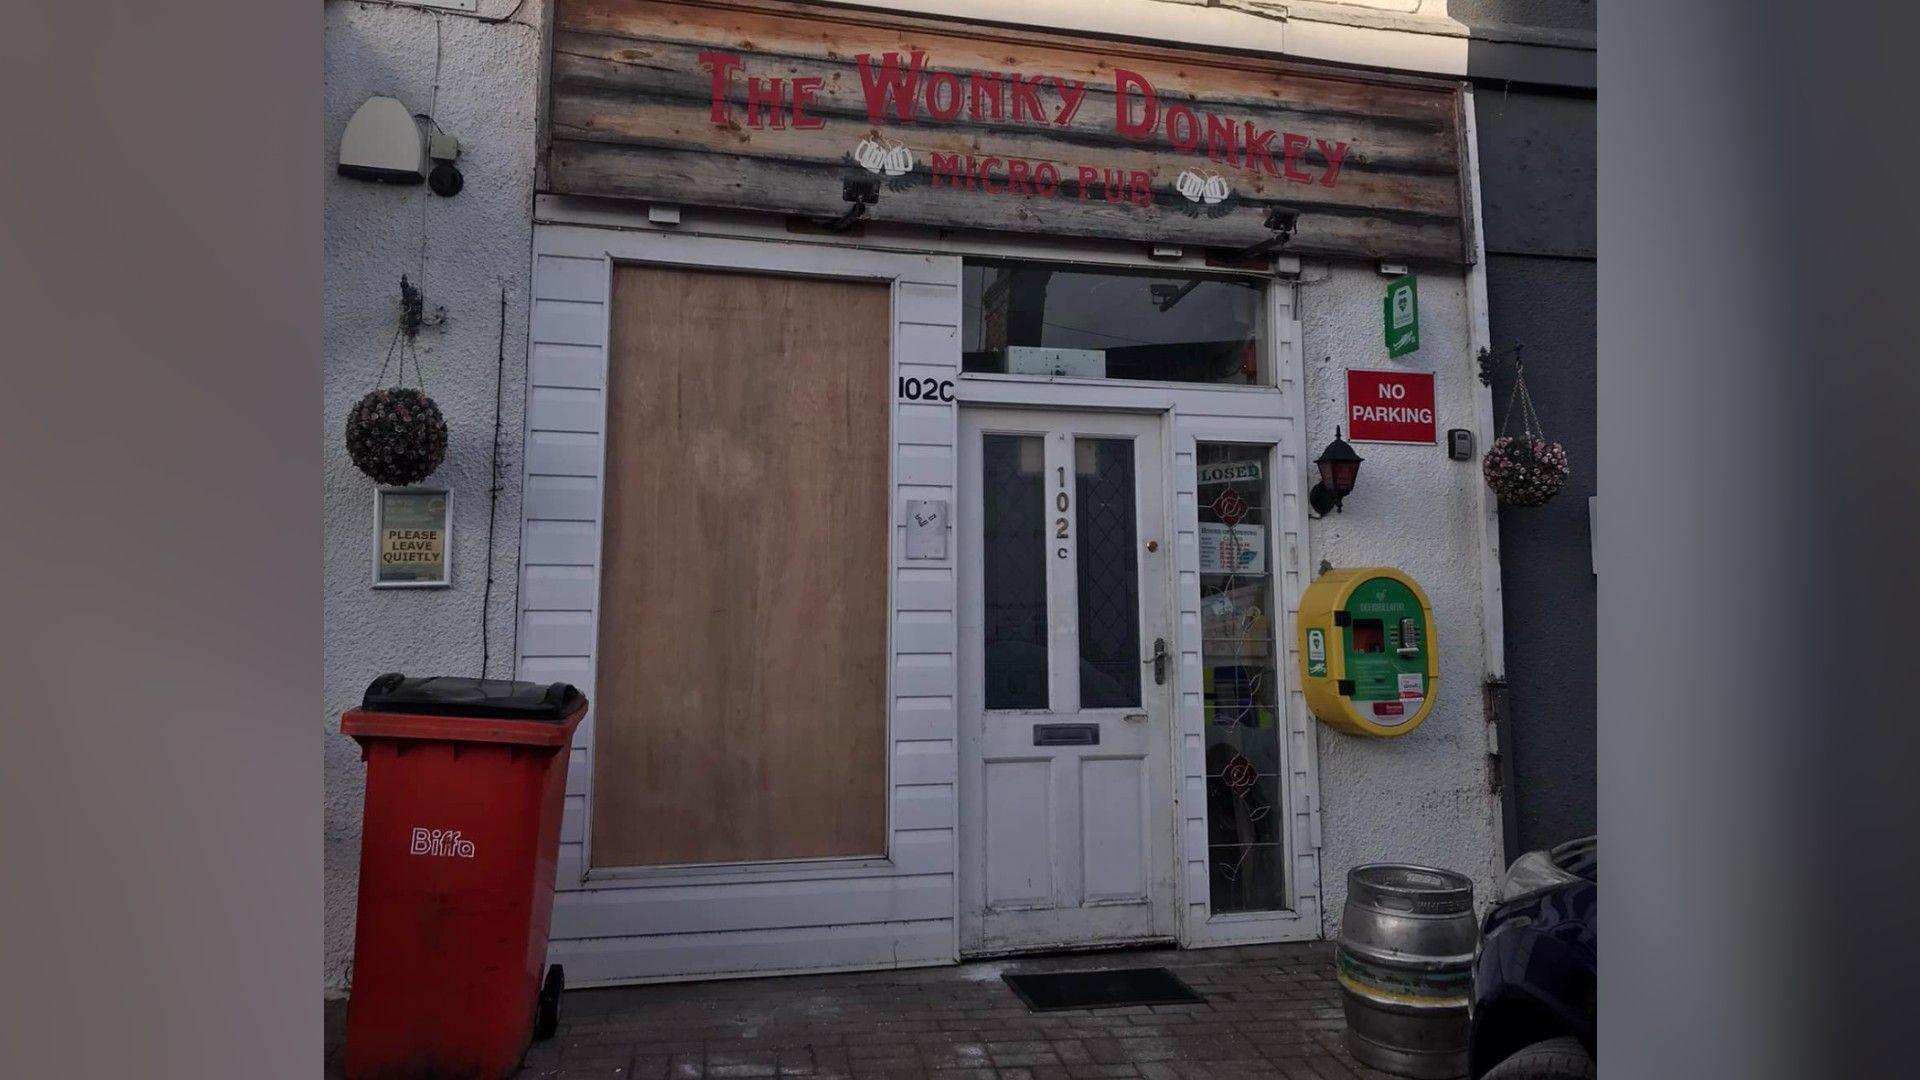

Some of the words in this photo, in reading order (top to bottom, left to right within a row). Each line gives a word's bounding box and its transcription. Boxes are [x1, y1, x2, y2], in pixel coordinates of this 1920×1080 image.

[699, 52, 827, 130] THE
[855, 50, 1086, 128] WONKY
[1114, 68, 1350, 188] DONKEY
[930, 151, 1061, 198] MICRO
[1078, 166, 1153, 206] PUB
[1378, 383, 1405, 400] NO
[1352, 406, 1433, 424] PARKING
[1197, 464, 1260, 482] LOSED
[388, 530, 437, 540] PLEASE
[392, 541, 433, 551] LEAVE
[383, 552, 441, 564] QUIETLY
[410, 827, 475, 858] Biffa
